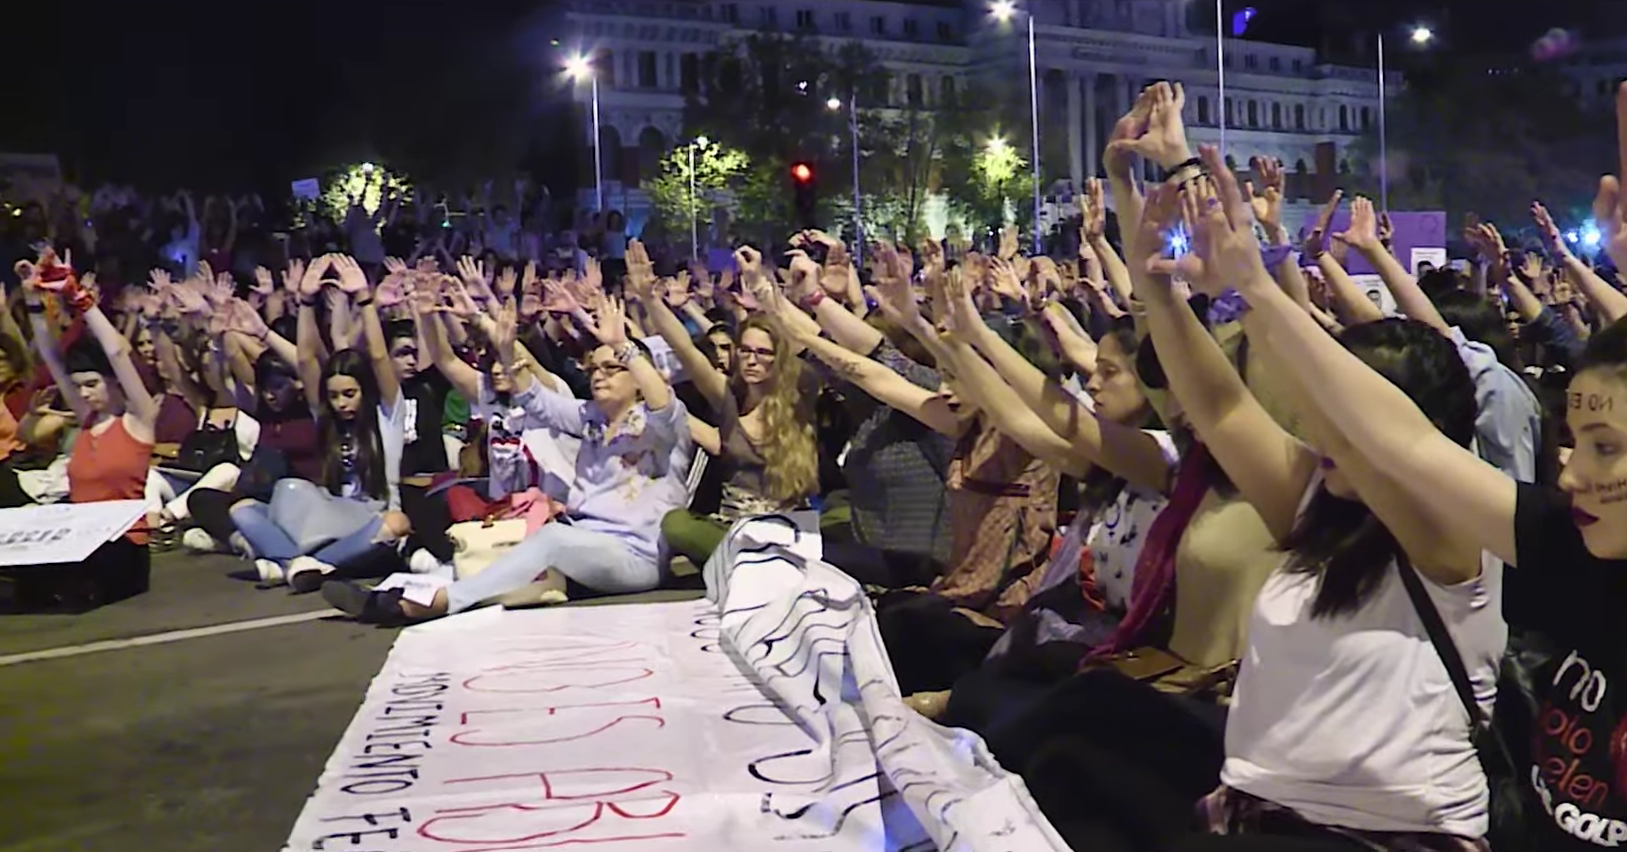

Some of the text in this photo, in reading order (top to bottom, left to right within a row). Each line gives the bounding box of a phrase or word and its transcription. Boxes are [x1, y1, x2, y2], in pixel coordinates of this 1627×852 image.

[1552, 649, 1607, 712] no
[340, 672, 451, 794] MOVIMIENTO
[416, 767, 688, 852] AB
